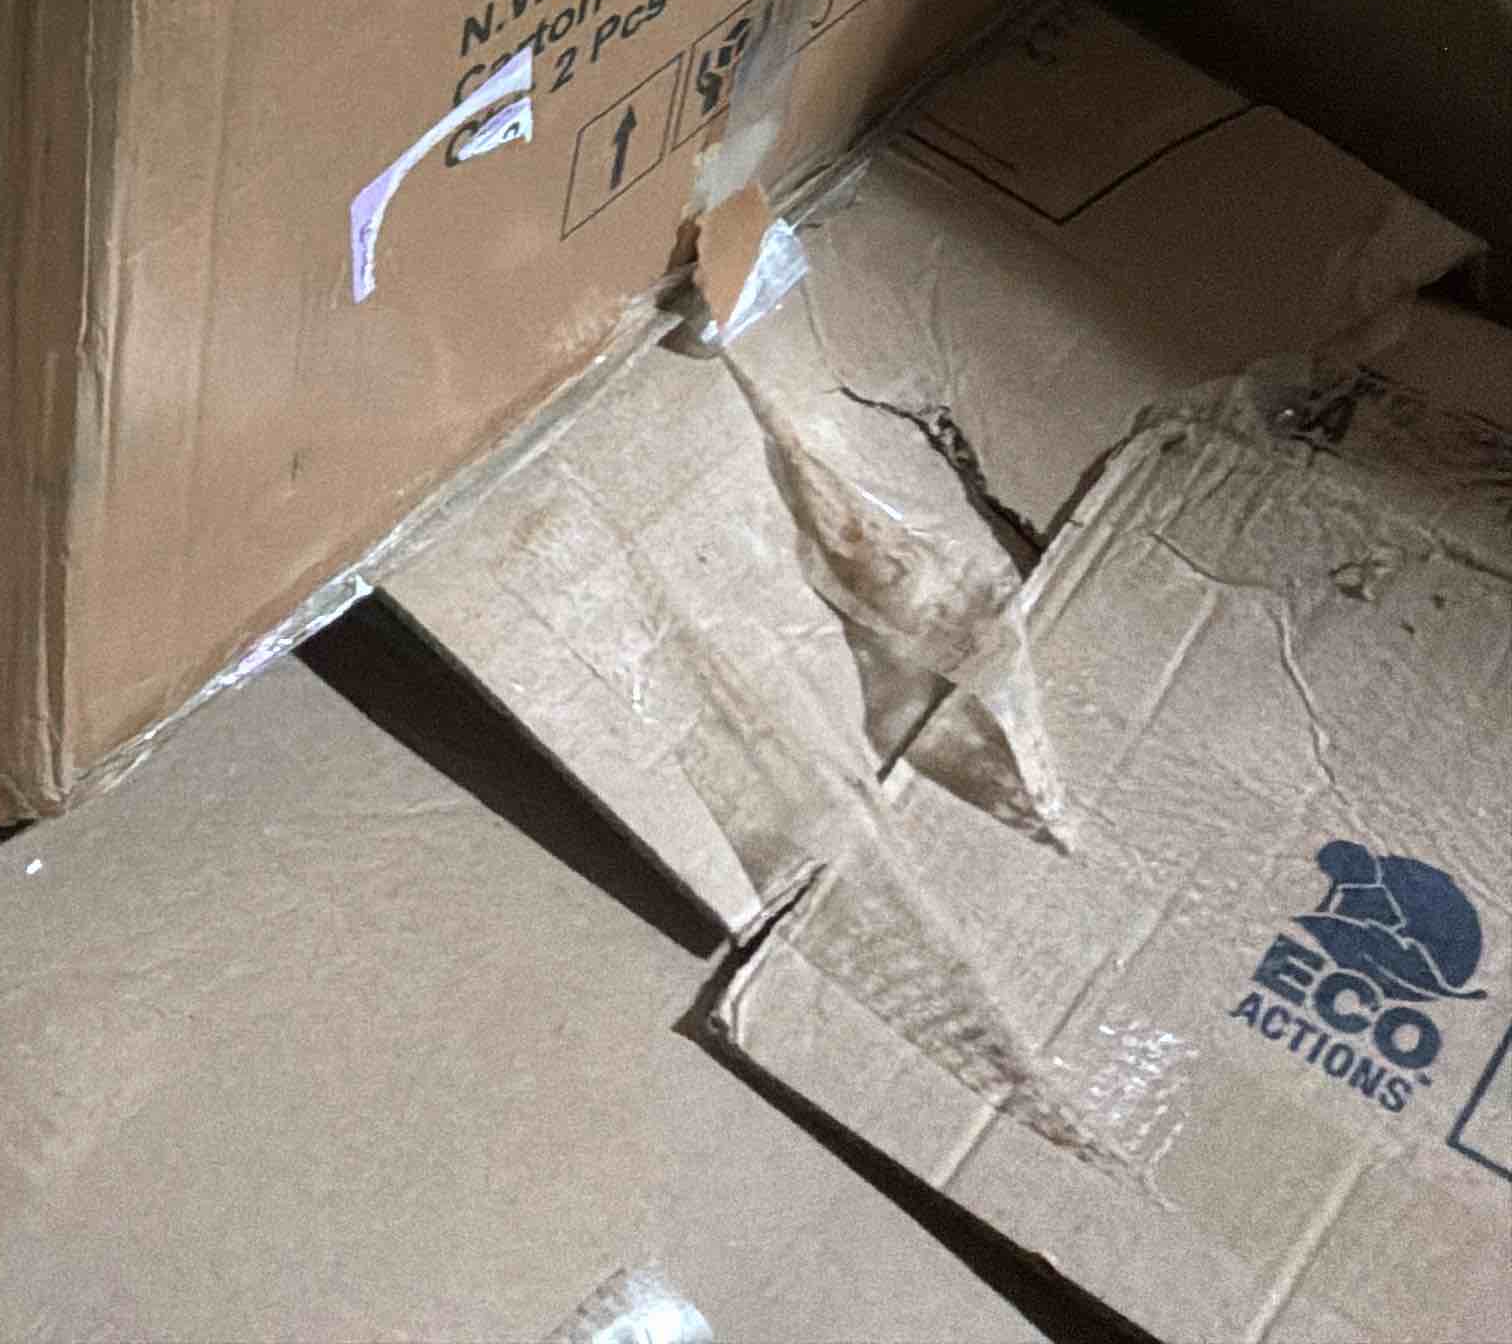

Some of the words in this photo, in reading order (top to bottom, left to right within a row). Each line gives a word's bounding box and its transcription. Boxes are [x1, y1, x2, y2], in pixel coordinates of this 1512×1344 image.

[550, 46, 578, 94] 2
[1227, 990, 1414, 1114] ACTIONS
[1251, 931, 1444, 1071] ECO
